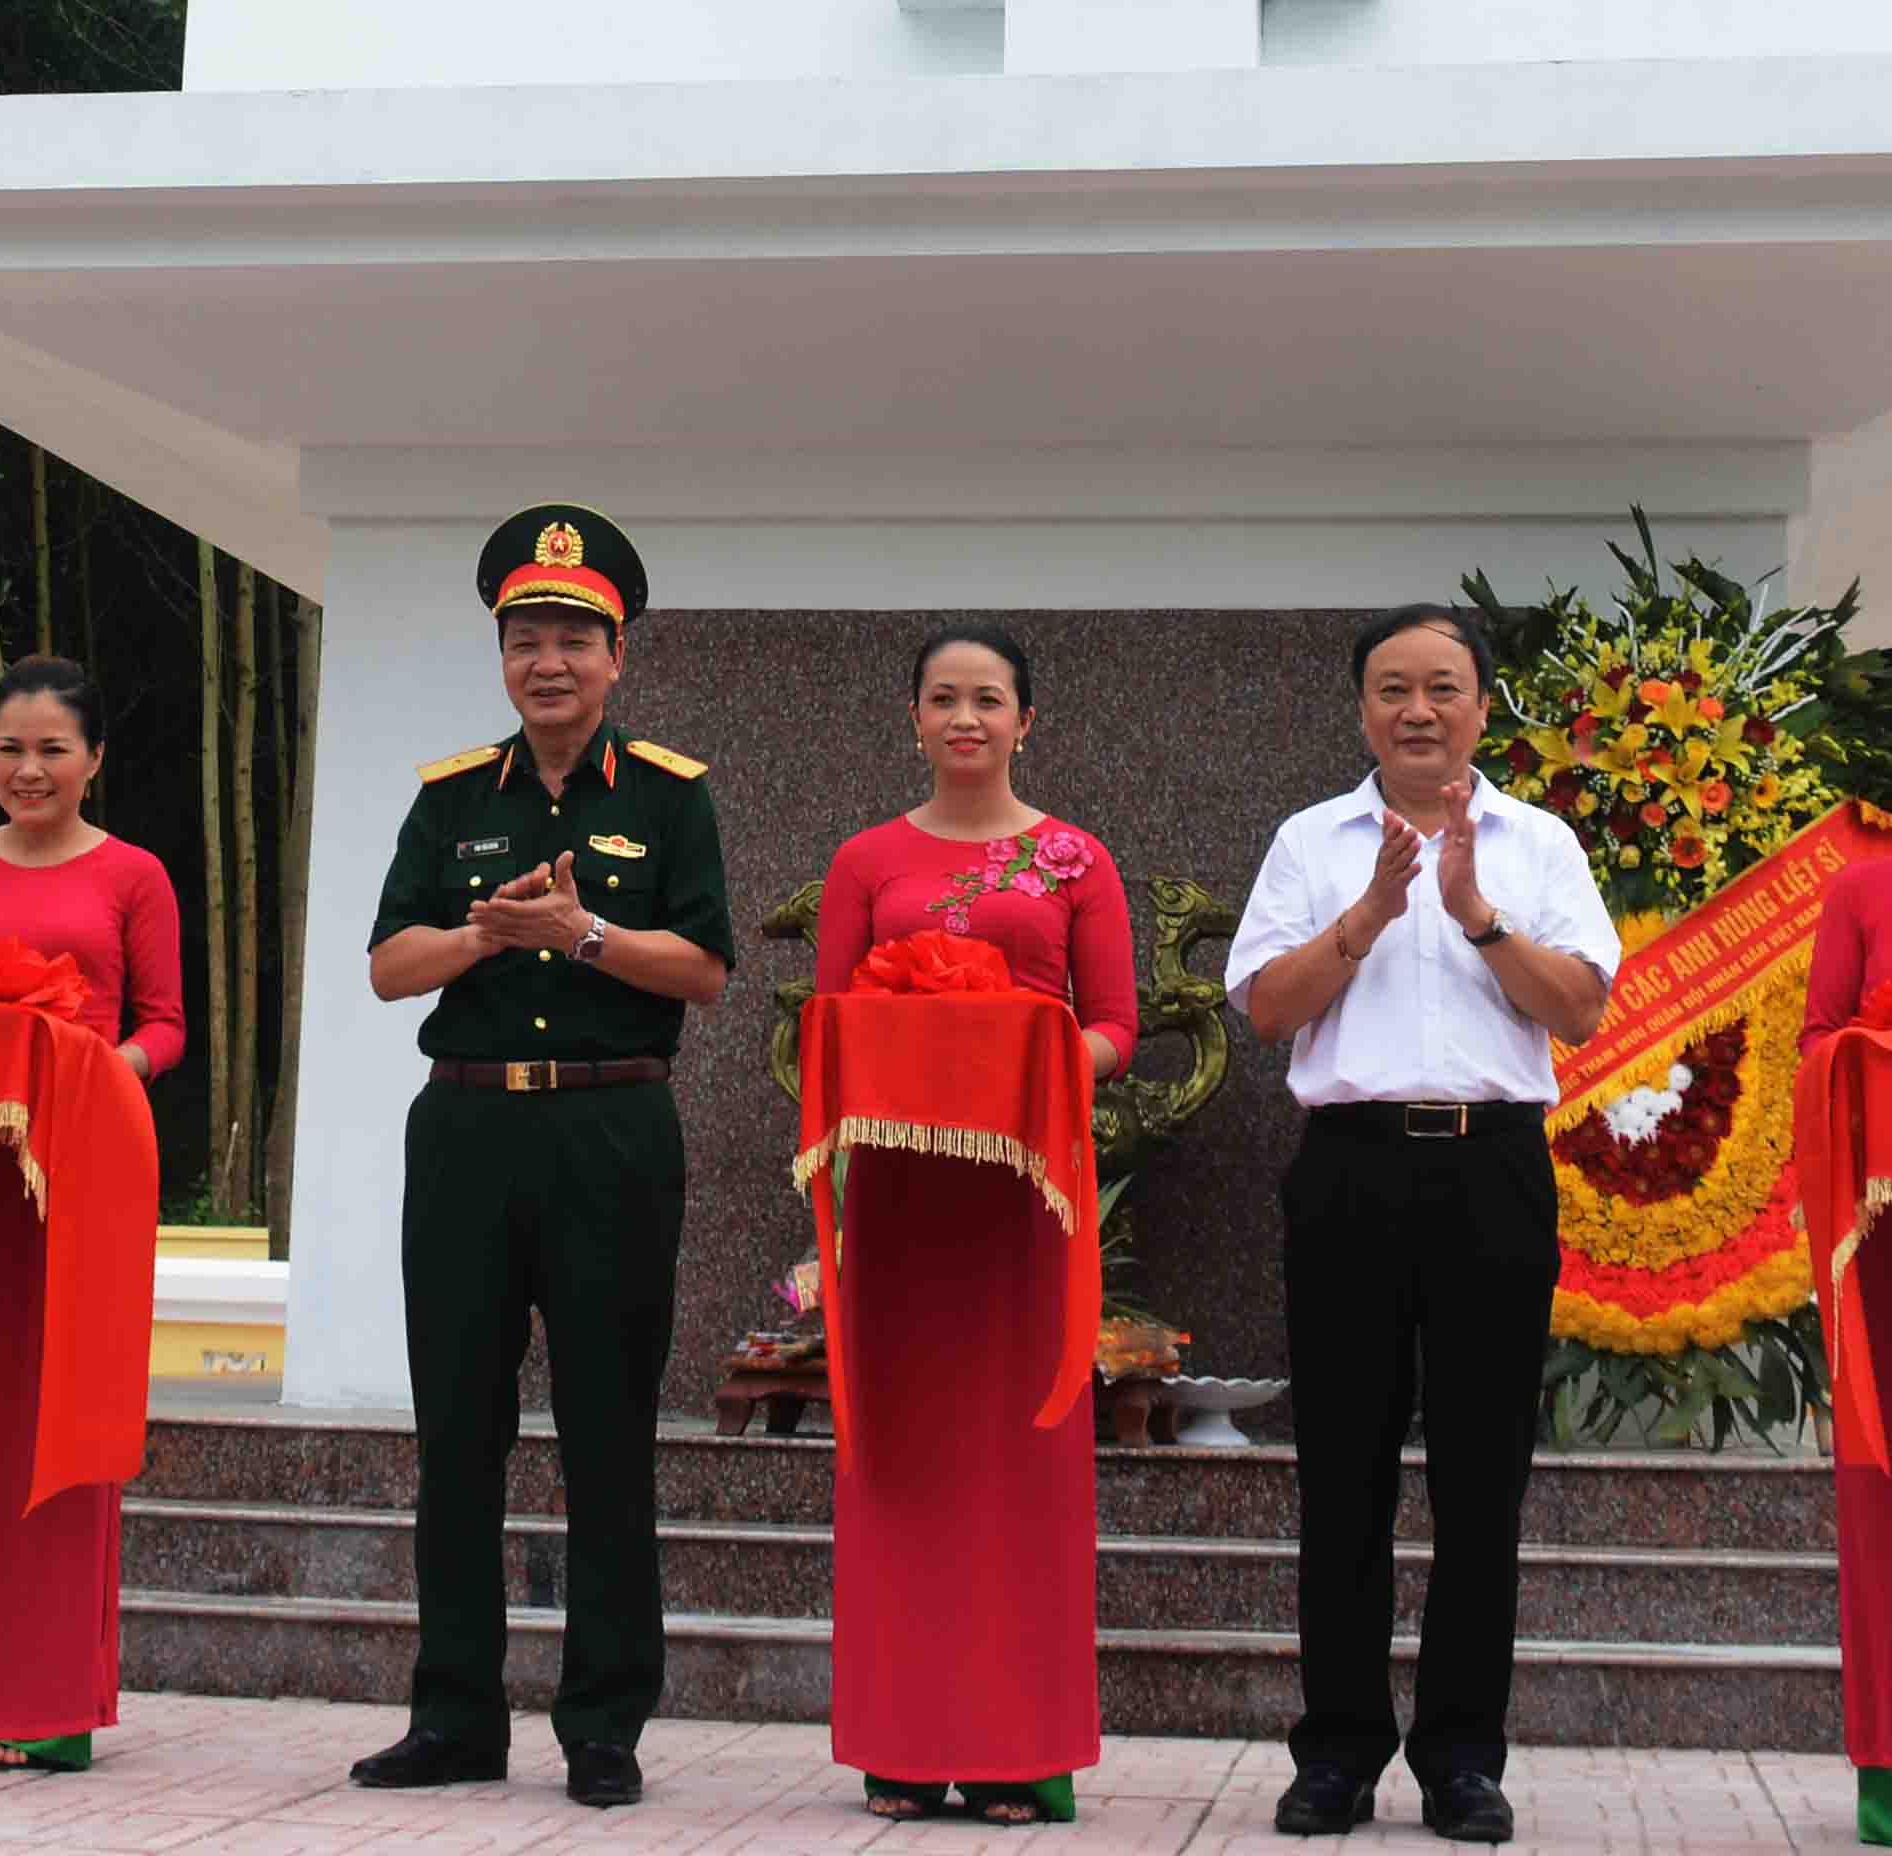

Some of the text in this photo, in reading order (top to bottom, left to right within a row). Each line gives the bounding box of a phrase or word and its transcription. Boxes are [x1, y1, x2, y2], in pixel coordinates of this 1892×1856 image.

[1619, 964, 1672, 1011] CÁC
[1666, 929, 1721, 982] ANH
[1711, 888, 1781, 948] HÙNG
[1771, 856, 1821, 905] LIỆT
